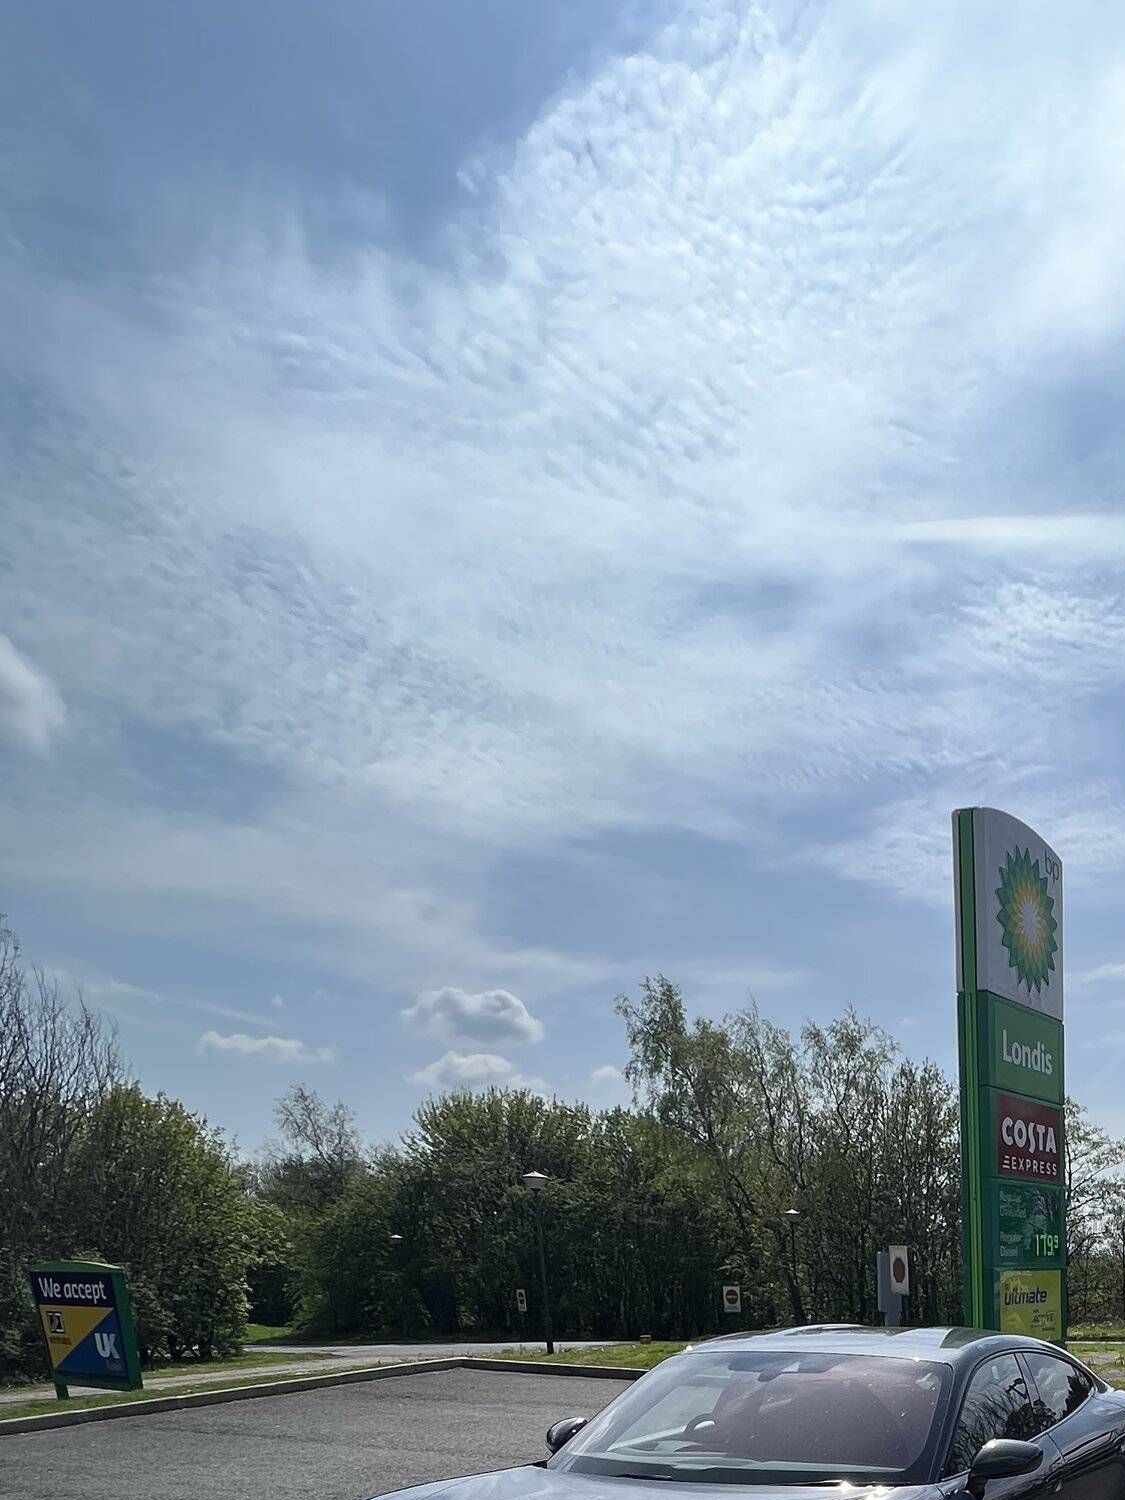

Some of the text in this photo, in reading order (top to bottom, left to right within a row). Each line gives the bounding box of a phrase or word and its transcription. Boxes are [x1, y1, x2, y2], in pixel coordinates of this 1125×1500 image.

[1044, 850, 1060, 884] bp
[1002, 1029, 1053, 1076] Londis
[1001, 1116, 1057, 1154] COSTA
[1011, 1156, 1057, 1176] EXPRESS
[38, 1277, 107, 1304] We accept
[94, 1333, 120, 1359] UK
